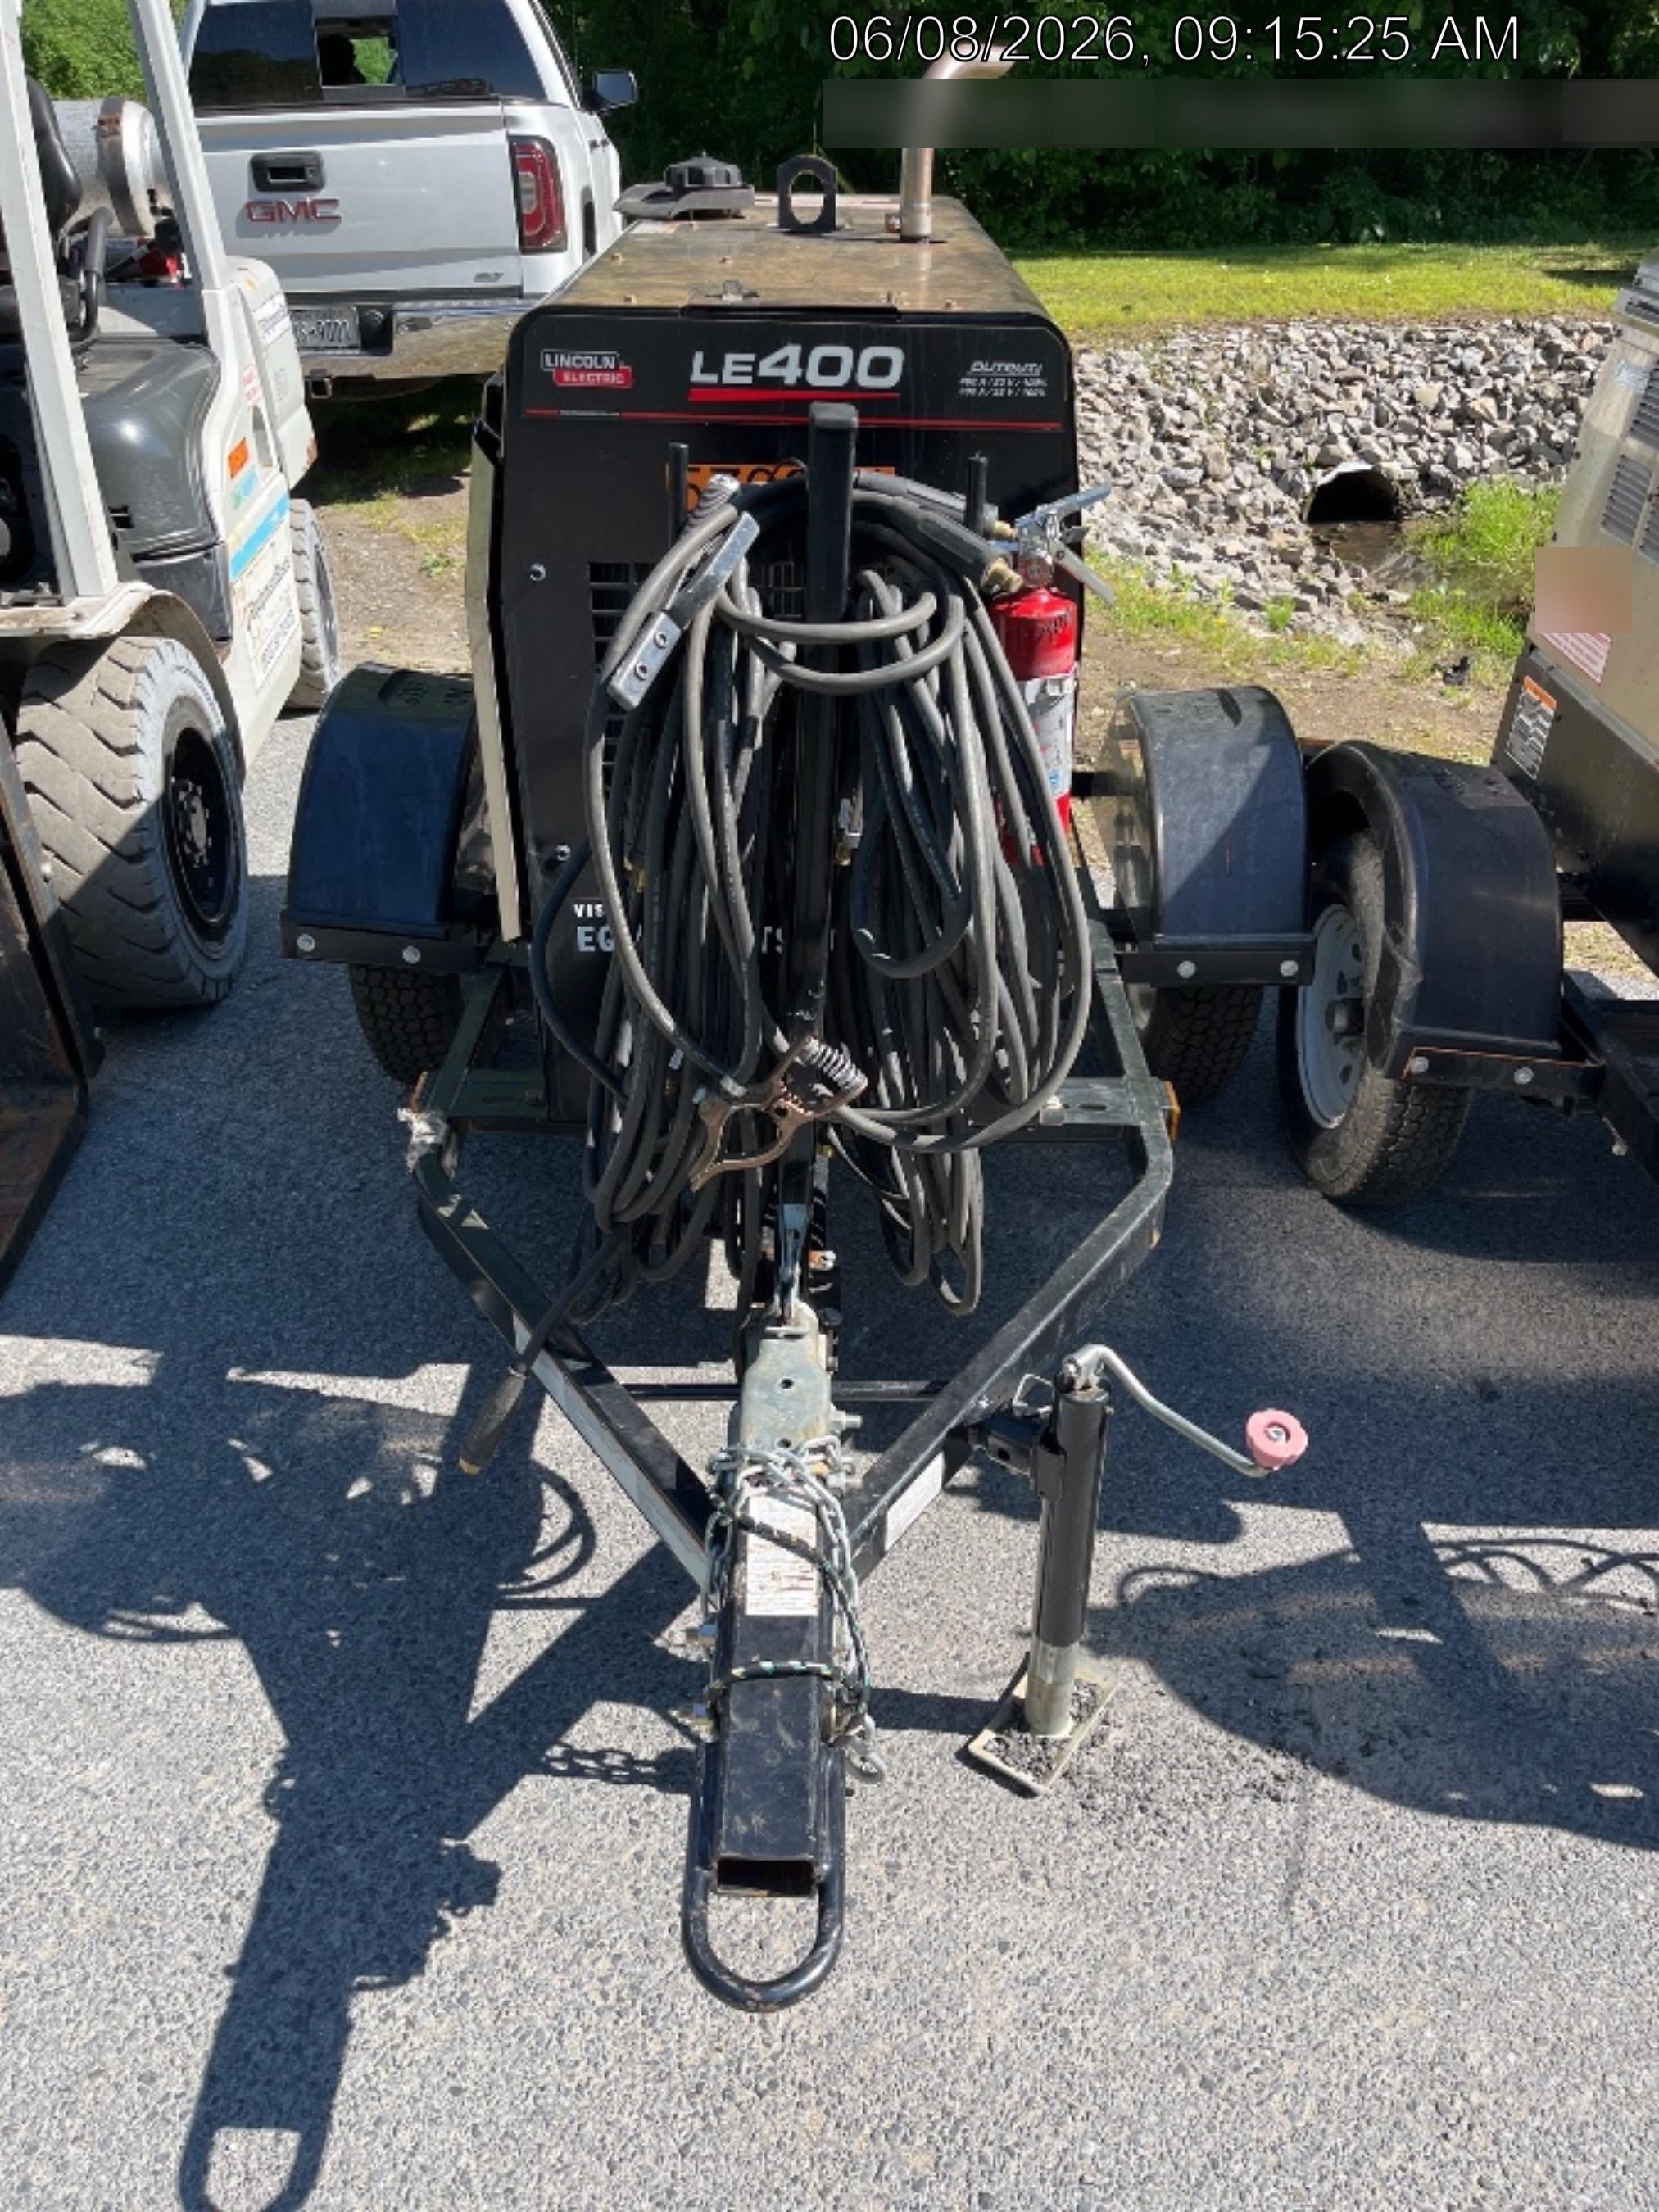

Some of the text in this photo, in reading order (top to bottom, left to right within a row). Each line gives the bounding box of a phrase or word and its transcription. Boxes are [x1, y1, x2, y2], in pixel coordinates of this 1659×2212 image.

[247, 197, 342, 222] GMC
[544, 353, 616, 370] LINCOLN
[690, 343, 905, 388] LE400
[562, 371, 625, 384] ELECTRIC
